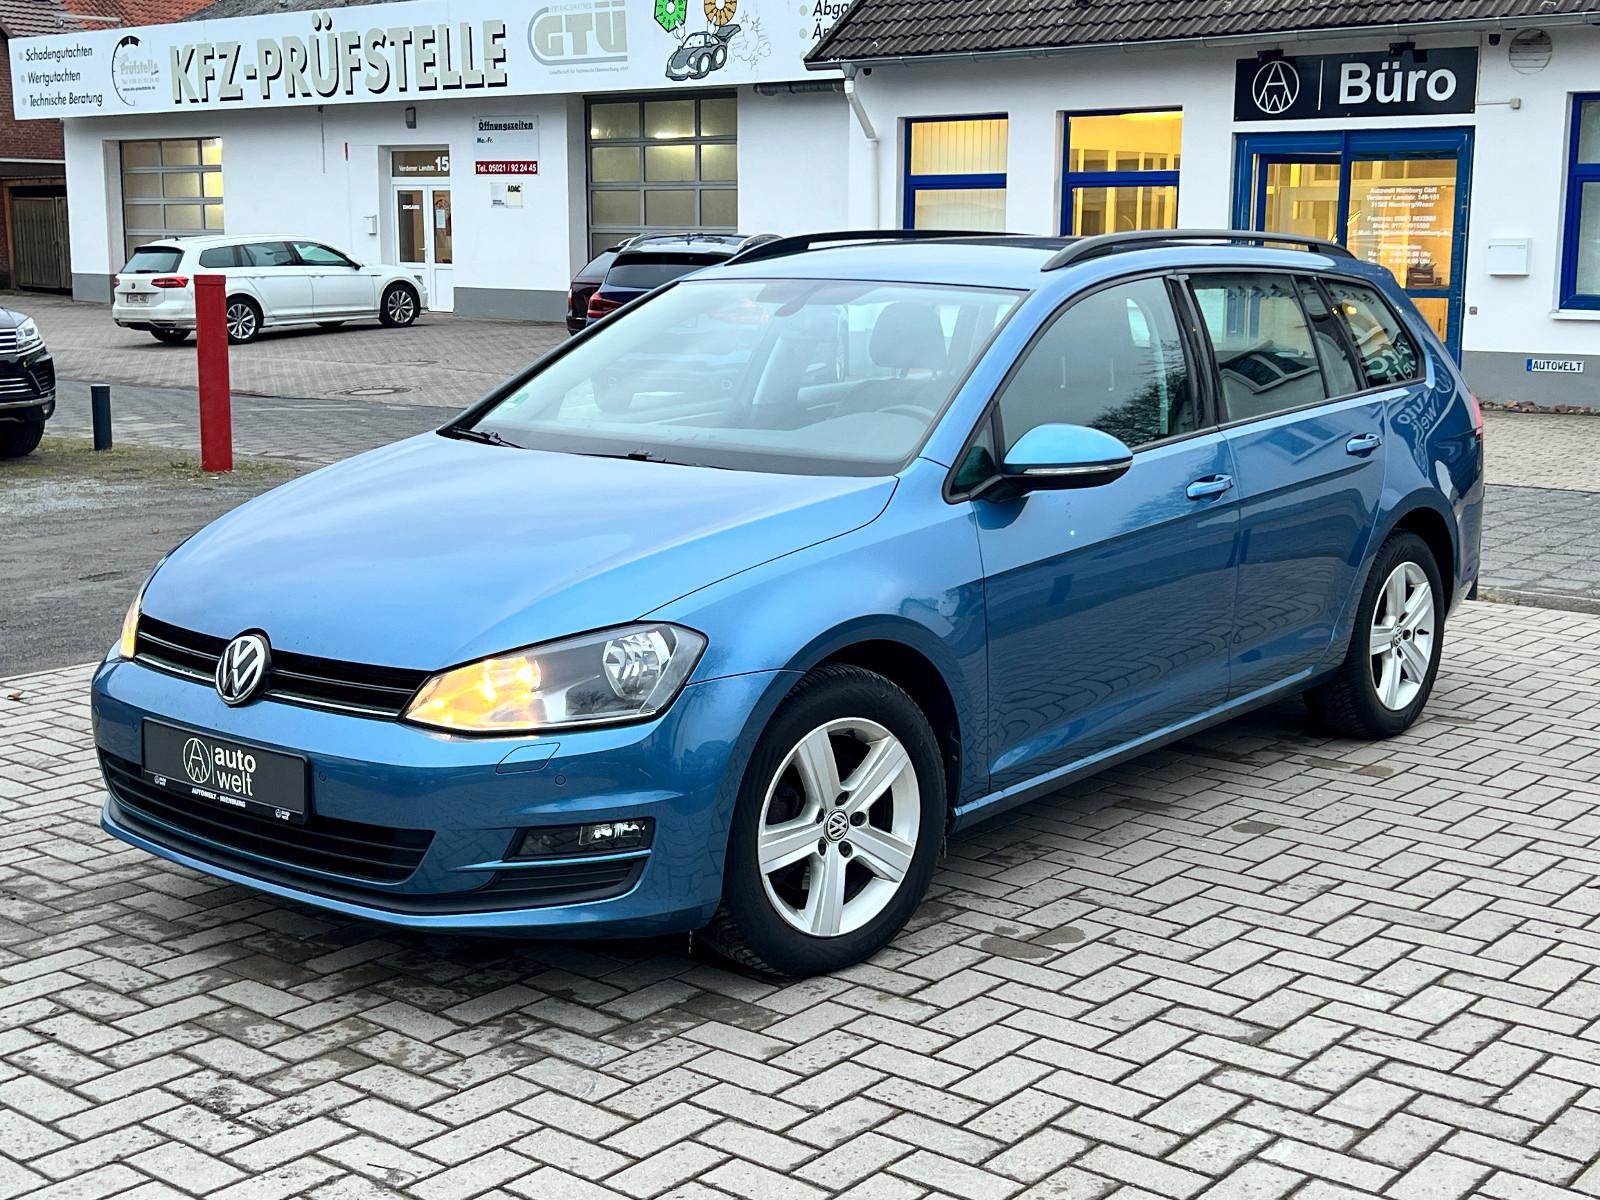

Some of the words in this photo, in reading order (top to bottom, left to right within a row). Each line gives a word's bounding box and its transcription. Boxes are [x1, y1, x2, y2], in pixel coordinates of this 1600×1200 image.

[534, 1, 627, 56] GTÜ
[25, 44, 94, 62] Schadengutachten
[169, 12, 508, 104] KFZ-PRÜFSTELLE
[28, 70, 81, 87] Wertgutachten
[1338, 61, 1457, 105] Büro
[29, 93, 67, 107] Technische
[68, 92, 103, 106] Beratung
[478, 119, 534, 131] Öffnungszeiten
[435, 156, 450, 172] 15
[476, 164, 488, 173] Tel.
[488, 164, 506, 173] 05021
[511, 164, 519, 173] 92
[520, 164, 528, 173] 24
[528, 163, 537, 173] 45
[1532, 360, 1582, 372] AUTOWELT
[214, 747, 257, 773] auto
[216, 769, 254, 797] welt
[191, 787, 217, 800] AUTOWELT
